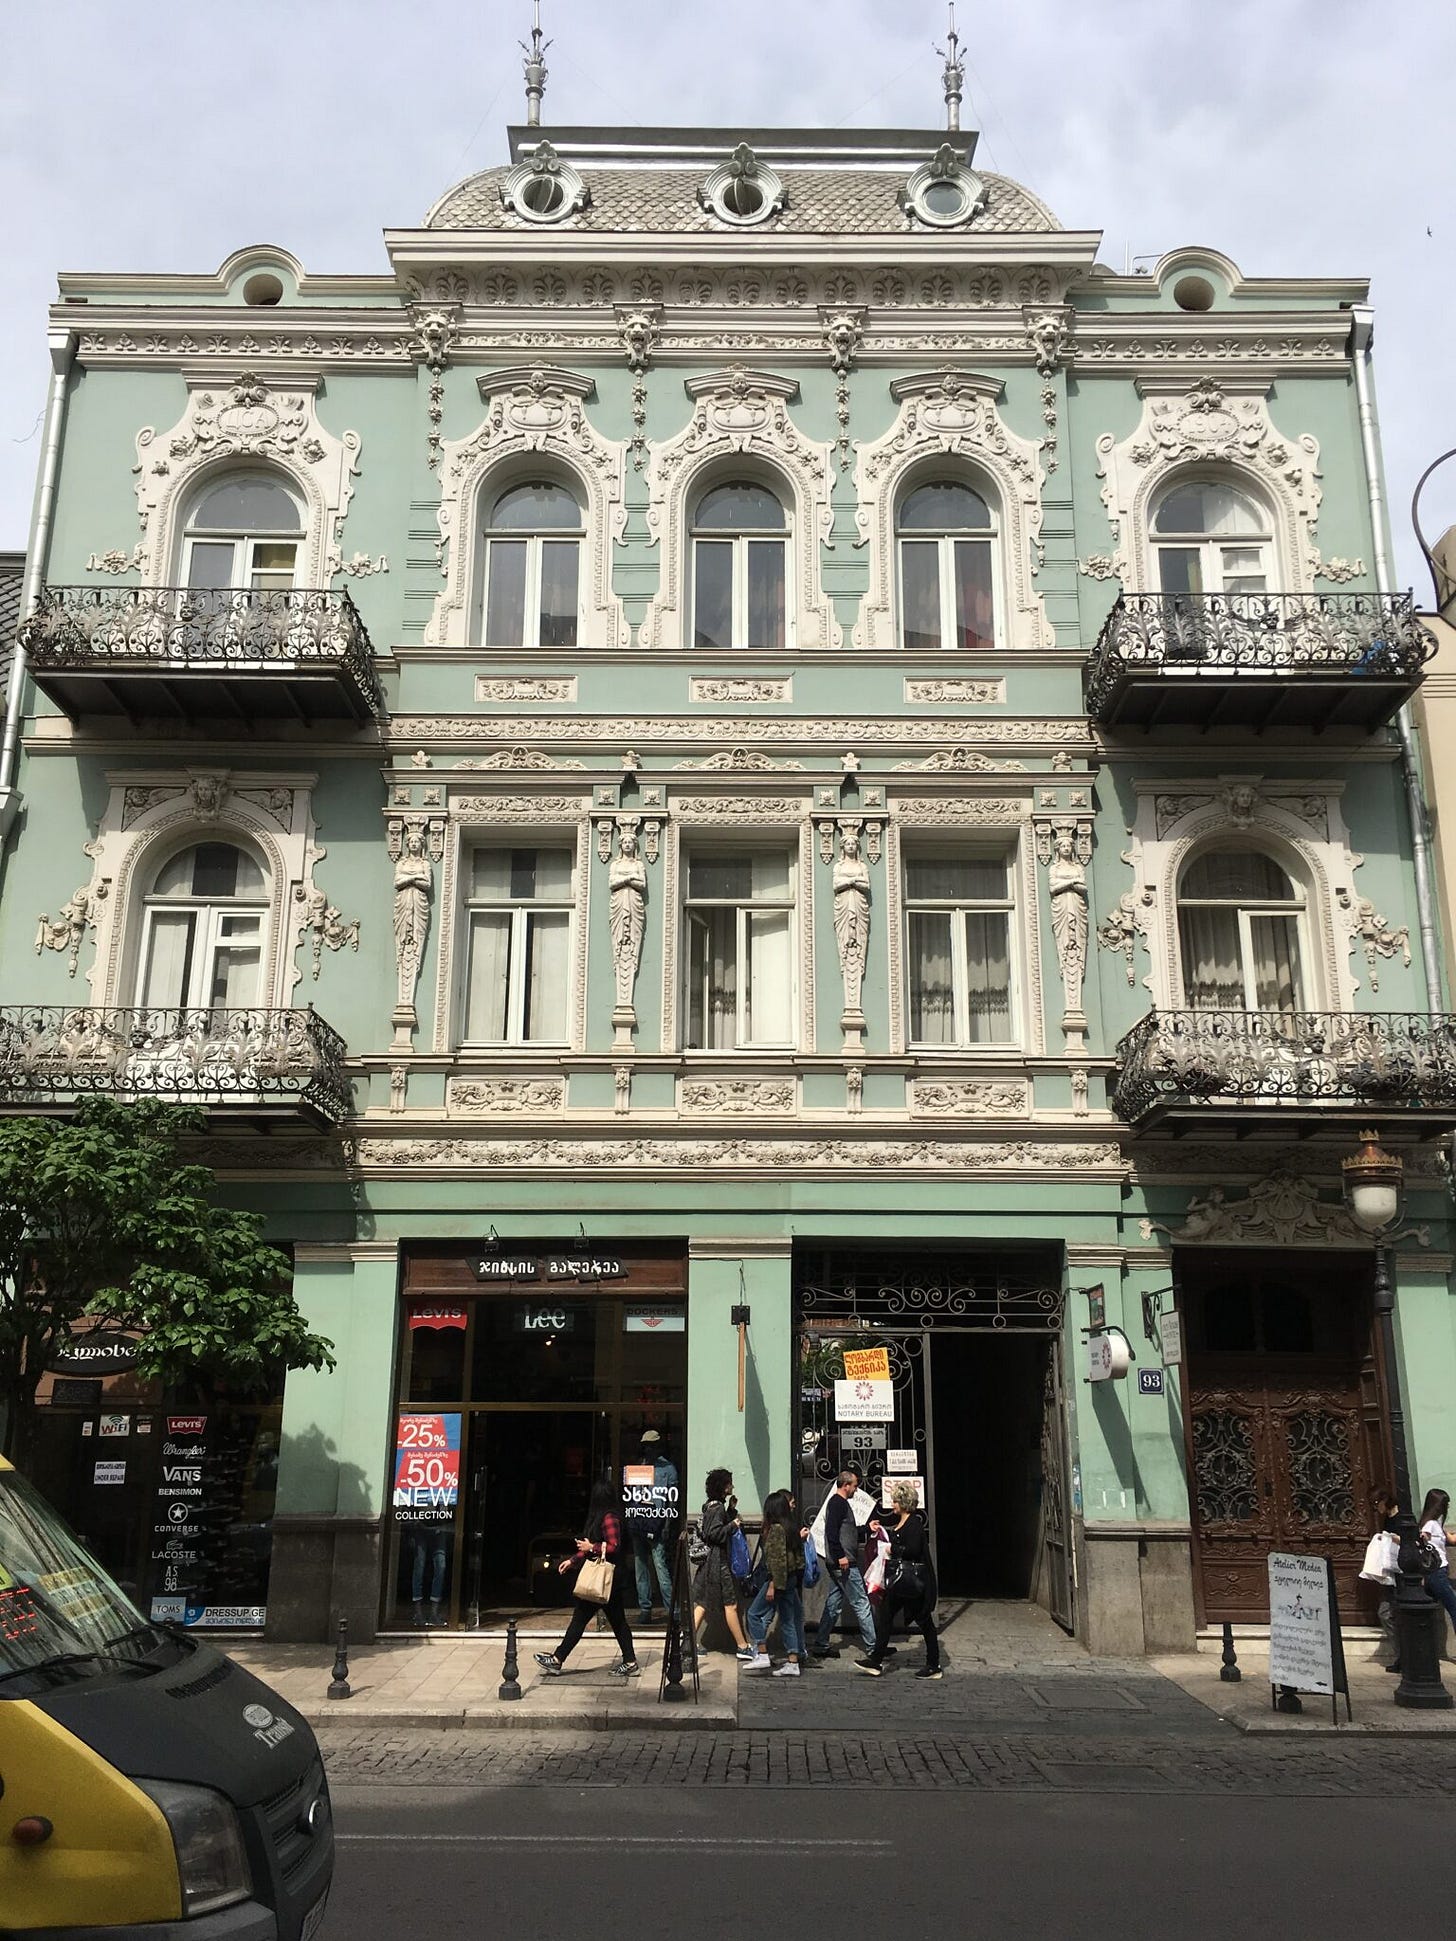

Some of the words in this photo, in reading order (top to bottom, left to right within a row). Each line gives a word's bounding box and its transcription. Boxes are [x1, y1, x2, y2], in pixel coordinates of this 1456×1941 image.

[479, 1261, 535, 1274] ჯინსის
[524, 1304, 566, 1329] Lee
[627, 1307, 678, 1315] DOCKERS
[1142, 1374, 1161, 1388] 93
[397, 1423, 446, 1448] -25%
[854, 1436, 873, 1448] 93
[162, 1441, 206, 1460] Wrangler
[163, 1466, 202, 1481] VANS
[400, 1458, 459, 1487] -50%
[158, 1488, 202, 1496] BENSIMON
[395, 1486, 453, 1508] NEW
[622, 1486, 679, 1502] ახალი
[394, 1510, 453, 1520] COLLECTION
[152, 1550, 197, 1559] LACOSTE
[164, 1577, 178, 1592] 98
[157, 1605, 180, 1614] TOMS
[205, 1608, 265, 1617] DRESSUP.GE
